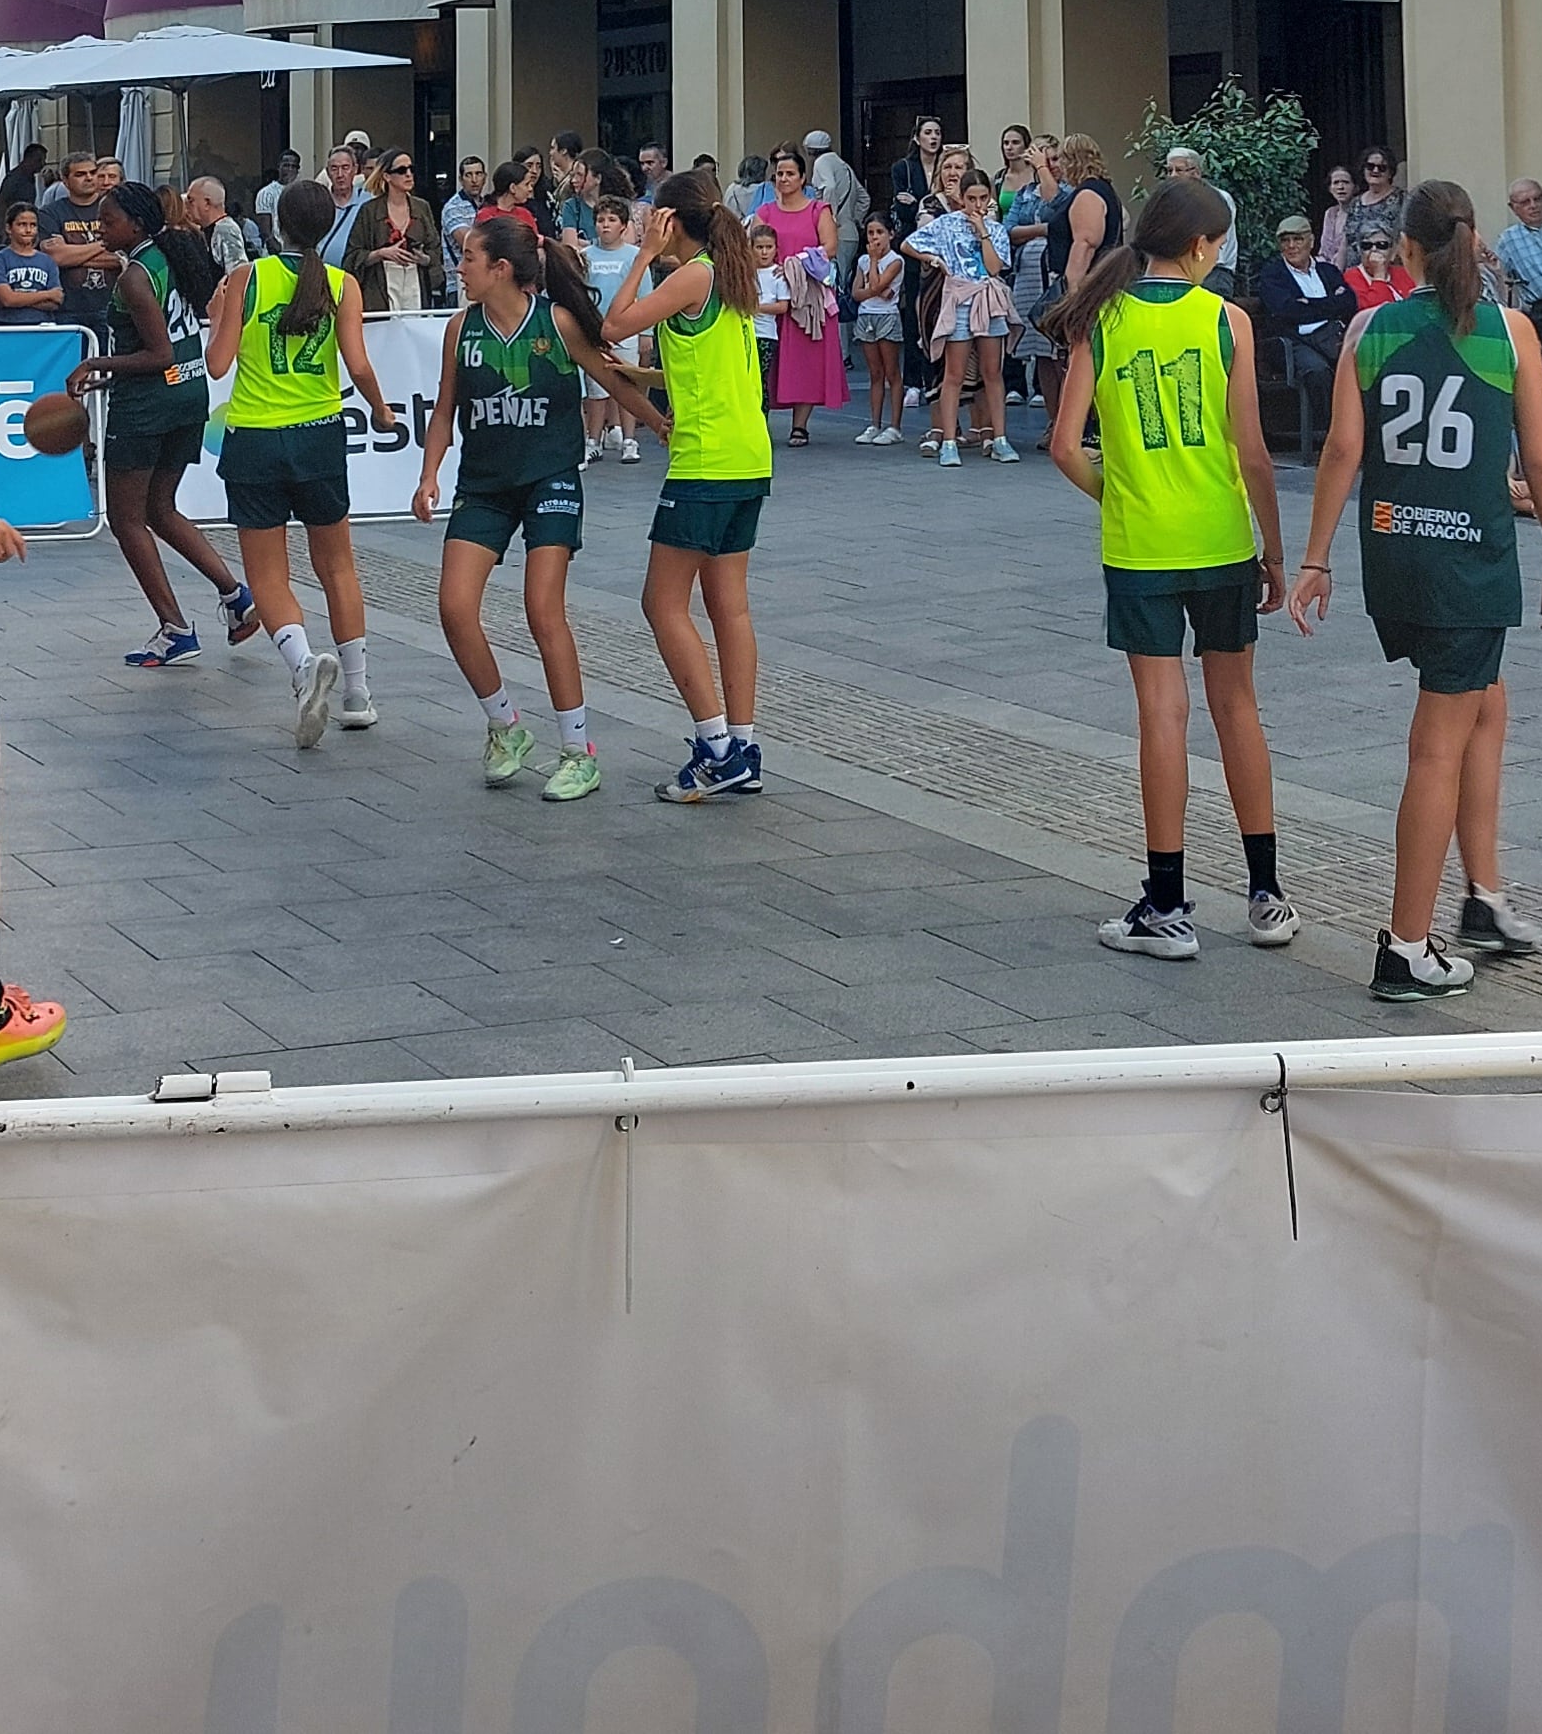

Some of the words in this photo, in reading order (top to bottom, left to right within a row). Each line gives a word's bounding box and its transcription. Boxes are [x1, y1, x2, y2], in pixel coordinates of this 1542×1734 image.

[258, 303, 333, 375] 12
[462, 339, 484, 368] 16
[1117, 348, 1206, 451] 11
[1380, 374, 1474, 469] 26
[1391, 505, 1471, 526] GOBIERNO
[1391, 521, 1412, 535] DE
[1414, 523, 1482, 543] ARAGON
